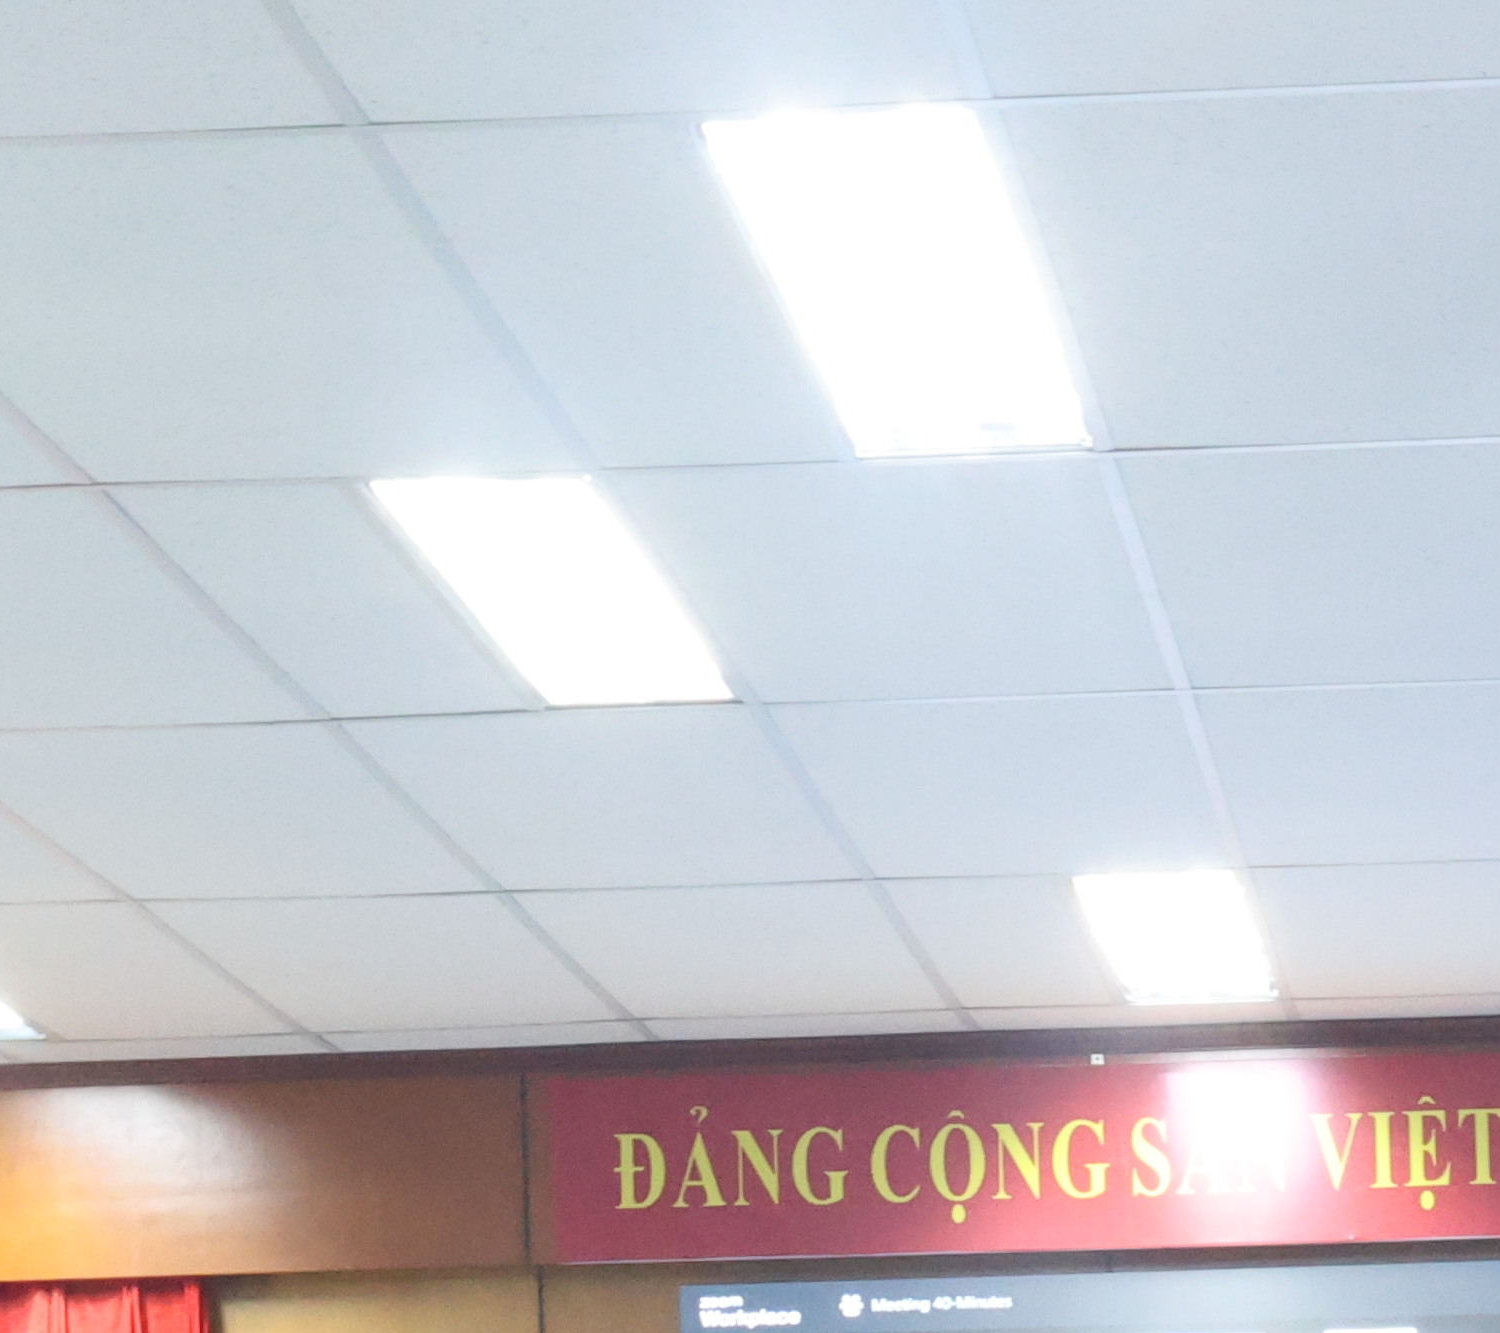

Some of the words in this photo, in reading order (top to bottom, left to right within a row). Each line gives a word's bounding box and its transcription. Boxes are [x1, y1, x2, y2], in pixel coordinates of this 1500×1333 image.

[613, 1105, 849, 1210] ĐẢNG
[870, 1109, 1110, 1225] CỘNG
[870, 1297, 931, 1314] Meeting
[698, 1308, 802, 1329] Workplace
